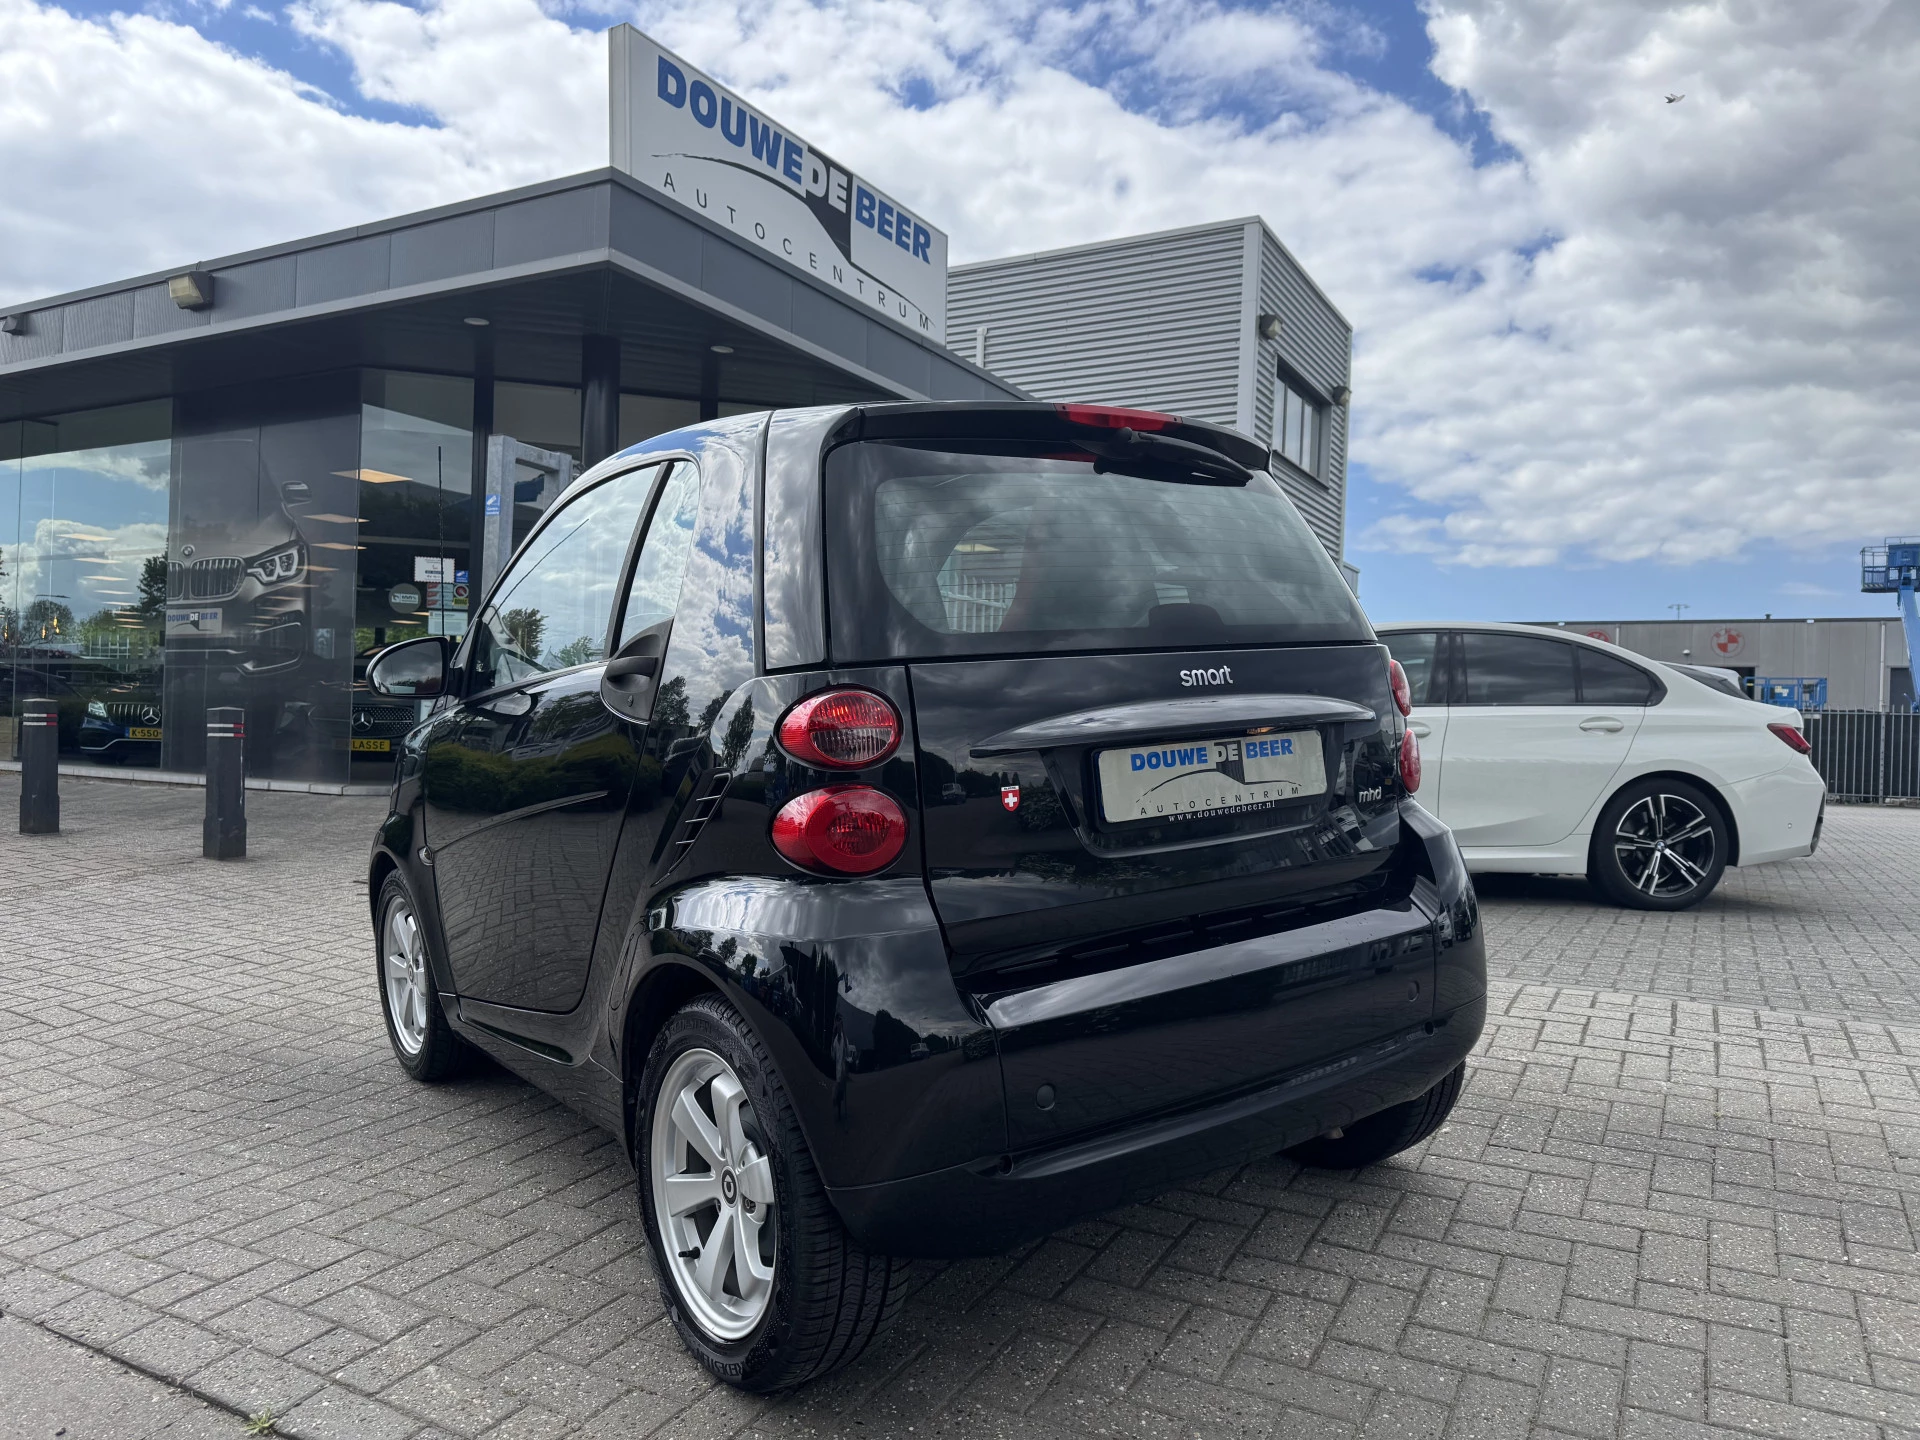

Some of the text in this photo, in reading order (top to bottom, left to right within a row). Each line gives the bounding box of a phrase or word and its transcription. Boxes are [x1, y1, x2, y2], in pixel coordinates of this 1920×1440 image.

[657, 54, 931, 265] DOUWE DE BEER
[663, 172, 929, 331] AUTOCENTRUM
[190, 612, 199, 621] DE
[1180, 665, 1234, 687] smart
[352, 740, 385, 750] LASSE
[1130, 738, 1294, 772] DOUWE DE BEER
[1140, 787, 1299, 816] AUTOCENTRUM
[1358, 786, 1382, 803] mhd
